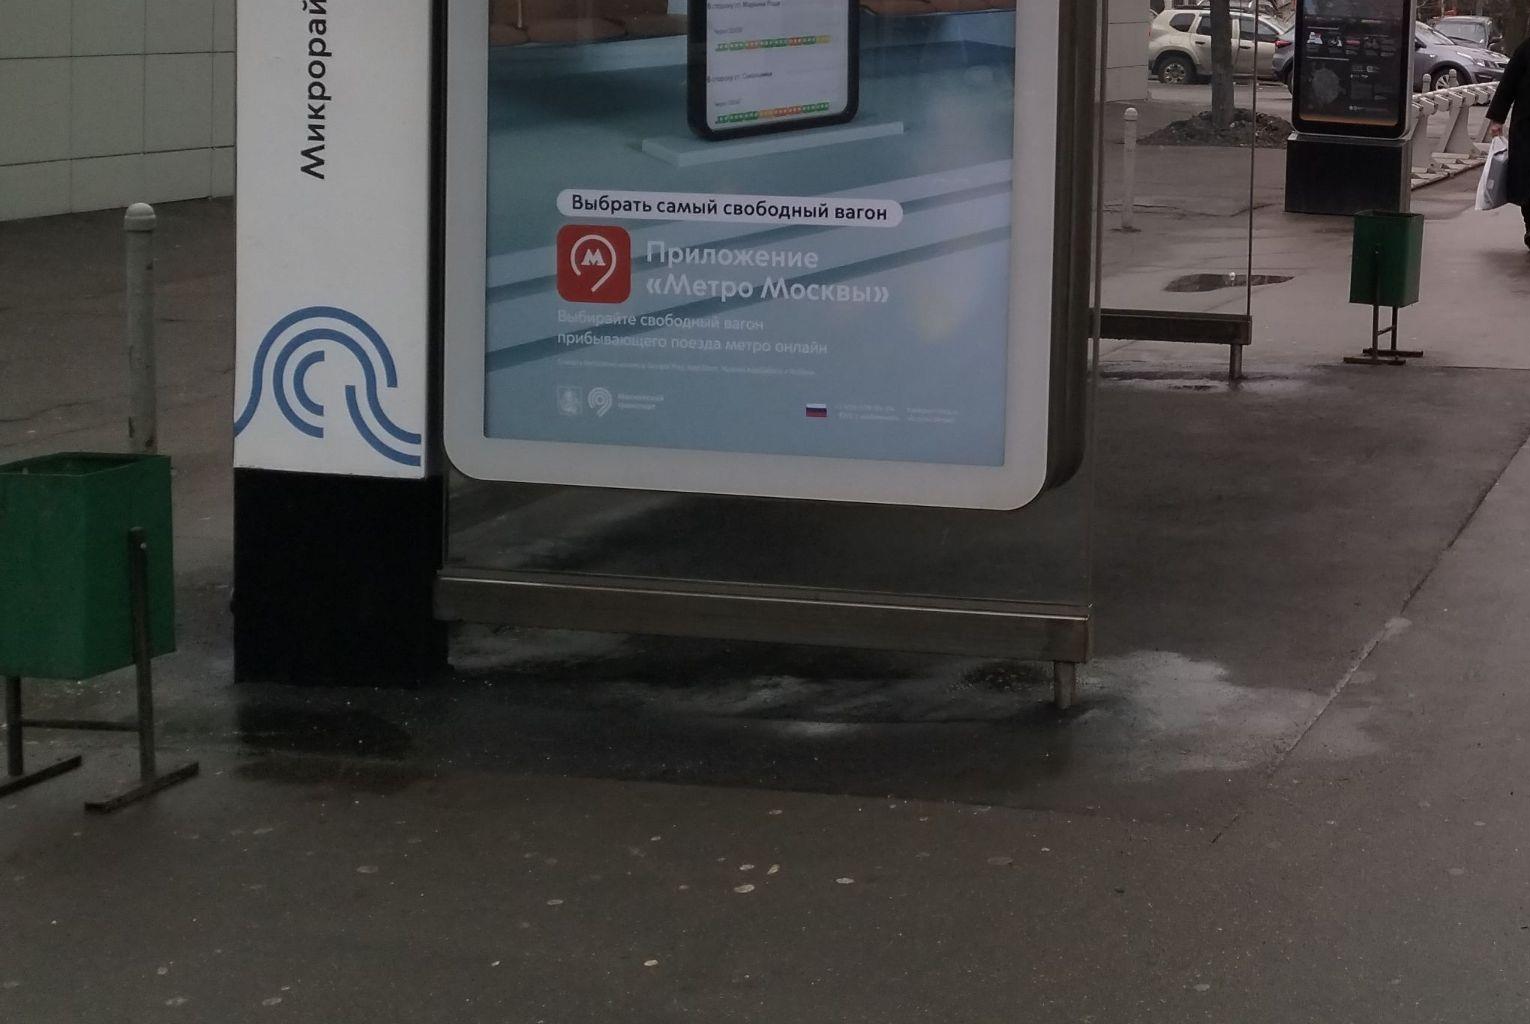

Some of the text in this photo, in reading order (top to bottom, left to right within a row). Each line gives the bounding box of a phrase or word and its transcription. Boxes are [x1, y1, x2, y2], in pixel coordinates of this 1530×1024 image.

[571, 195, 888, 223] Выбрать самый свободный вагон
[647, 241, 819, 269] Приложение
[646, 274, 890, 304] «Метро Москвы»
[557, 310, 763, 330] Выбирайте свободный вагон
[557, 332, 827, 355] прибывающего поезда метро онлайн
